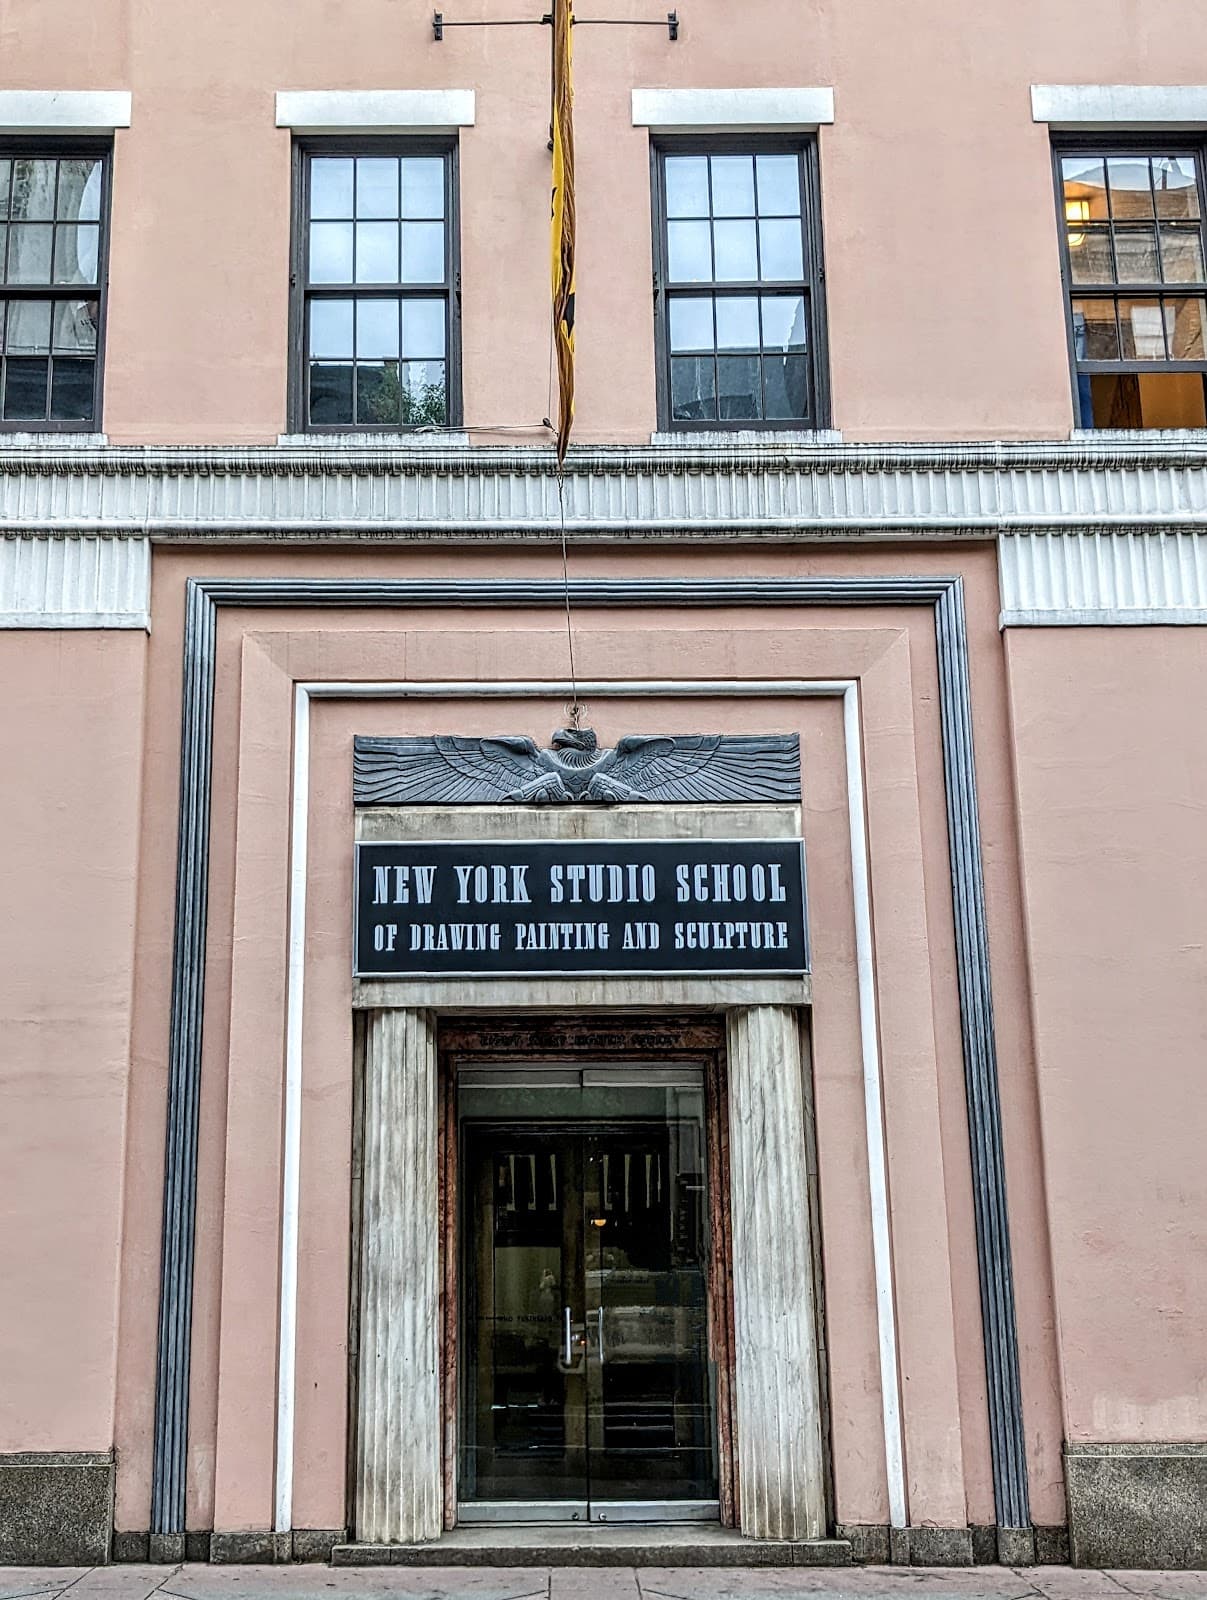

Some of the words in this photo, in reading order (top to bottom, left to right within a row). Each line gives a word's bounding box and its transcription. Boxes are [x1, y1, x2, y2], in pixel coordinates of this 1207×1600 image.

[373, 865, 438, 904] NEW
[453, 865, 532, 904] YORK
[550, 864, 656, 903] STUDIO
[676, 863, 787, 902] SCHOOL
[374, 923, 398, 951] OF
[409, 922, 502, 951] DRAWING
[514, 922, 610, 950] PAINTING
[621, 922, 660, 950] AND
[674, 921, 789, 949] SCULPTURE
